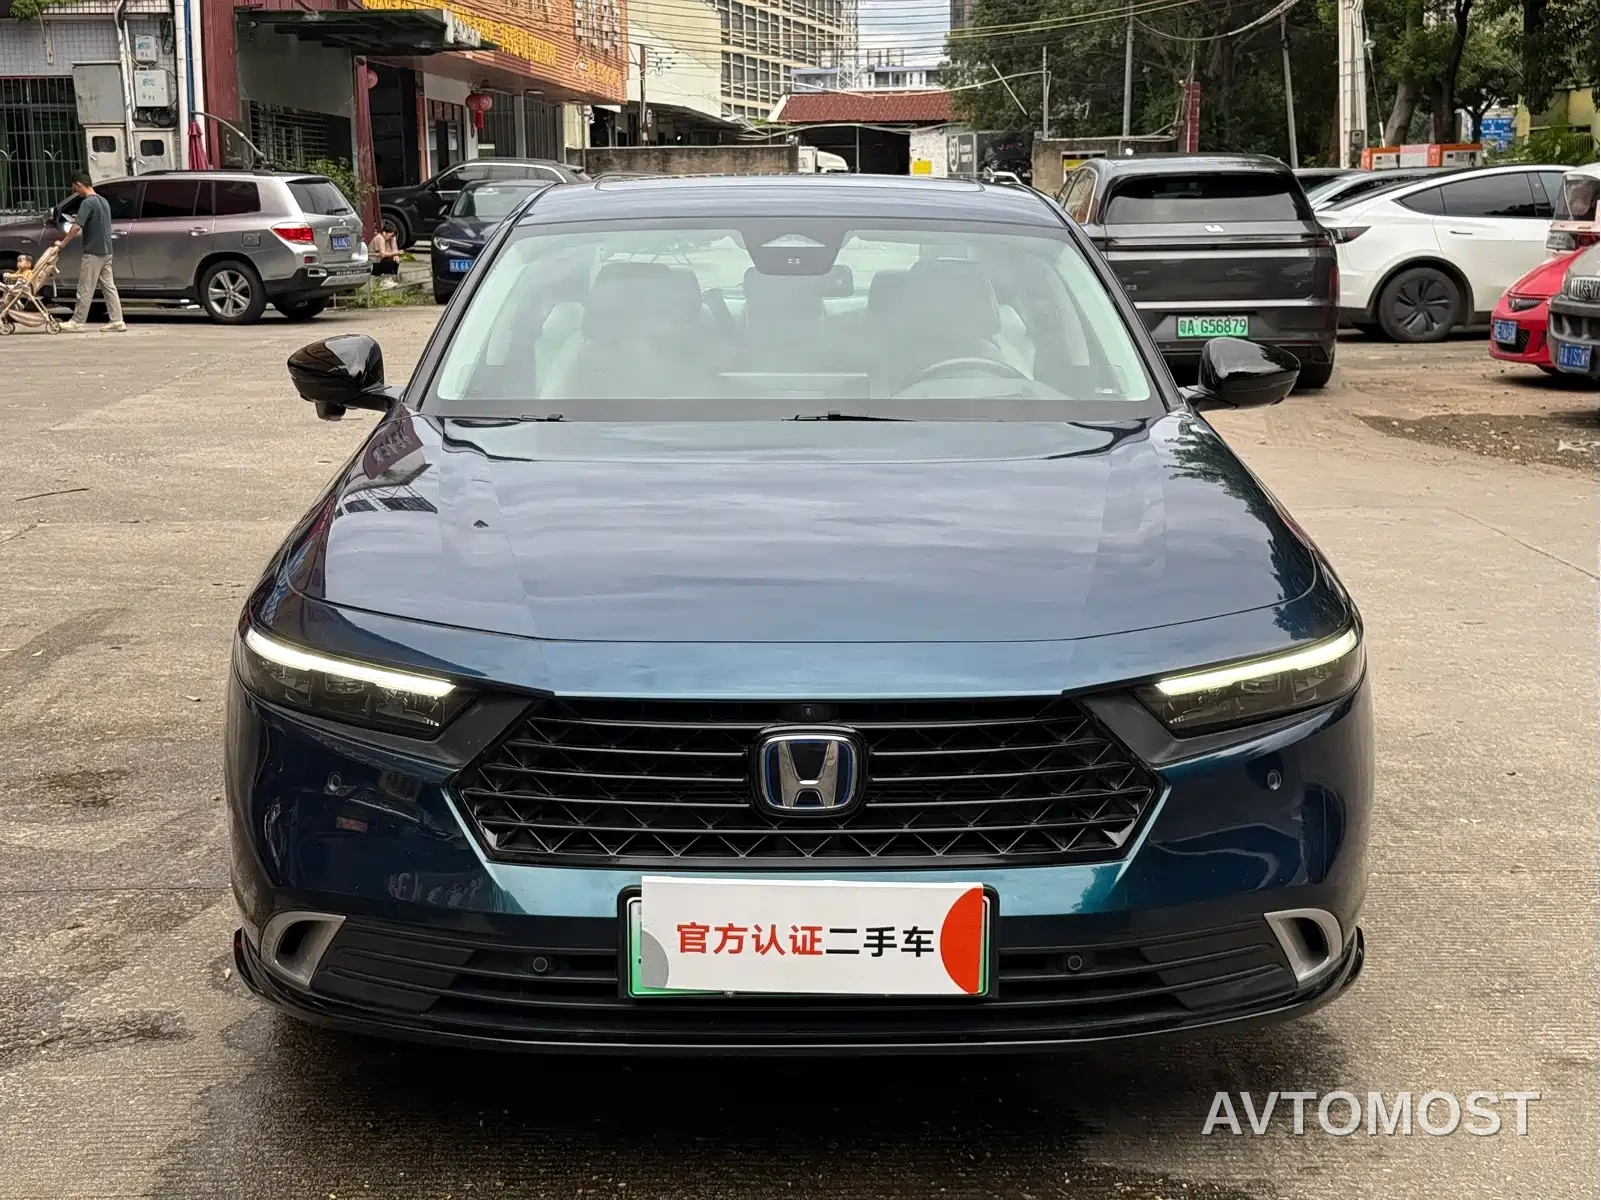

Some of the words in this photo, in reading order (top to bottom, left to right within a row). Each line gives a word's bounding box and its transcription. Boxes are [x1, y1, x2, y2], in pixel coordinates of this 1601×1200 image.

[676, 921, 935, 958] 官方认证二手车
